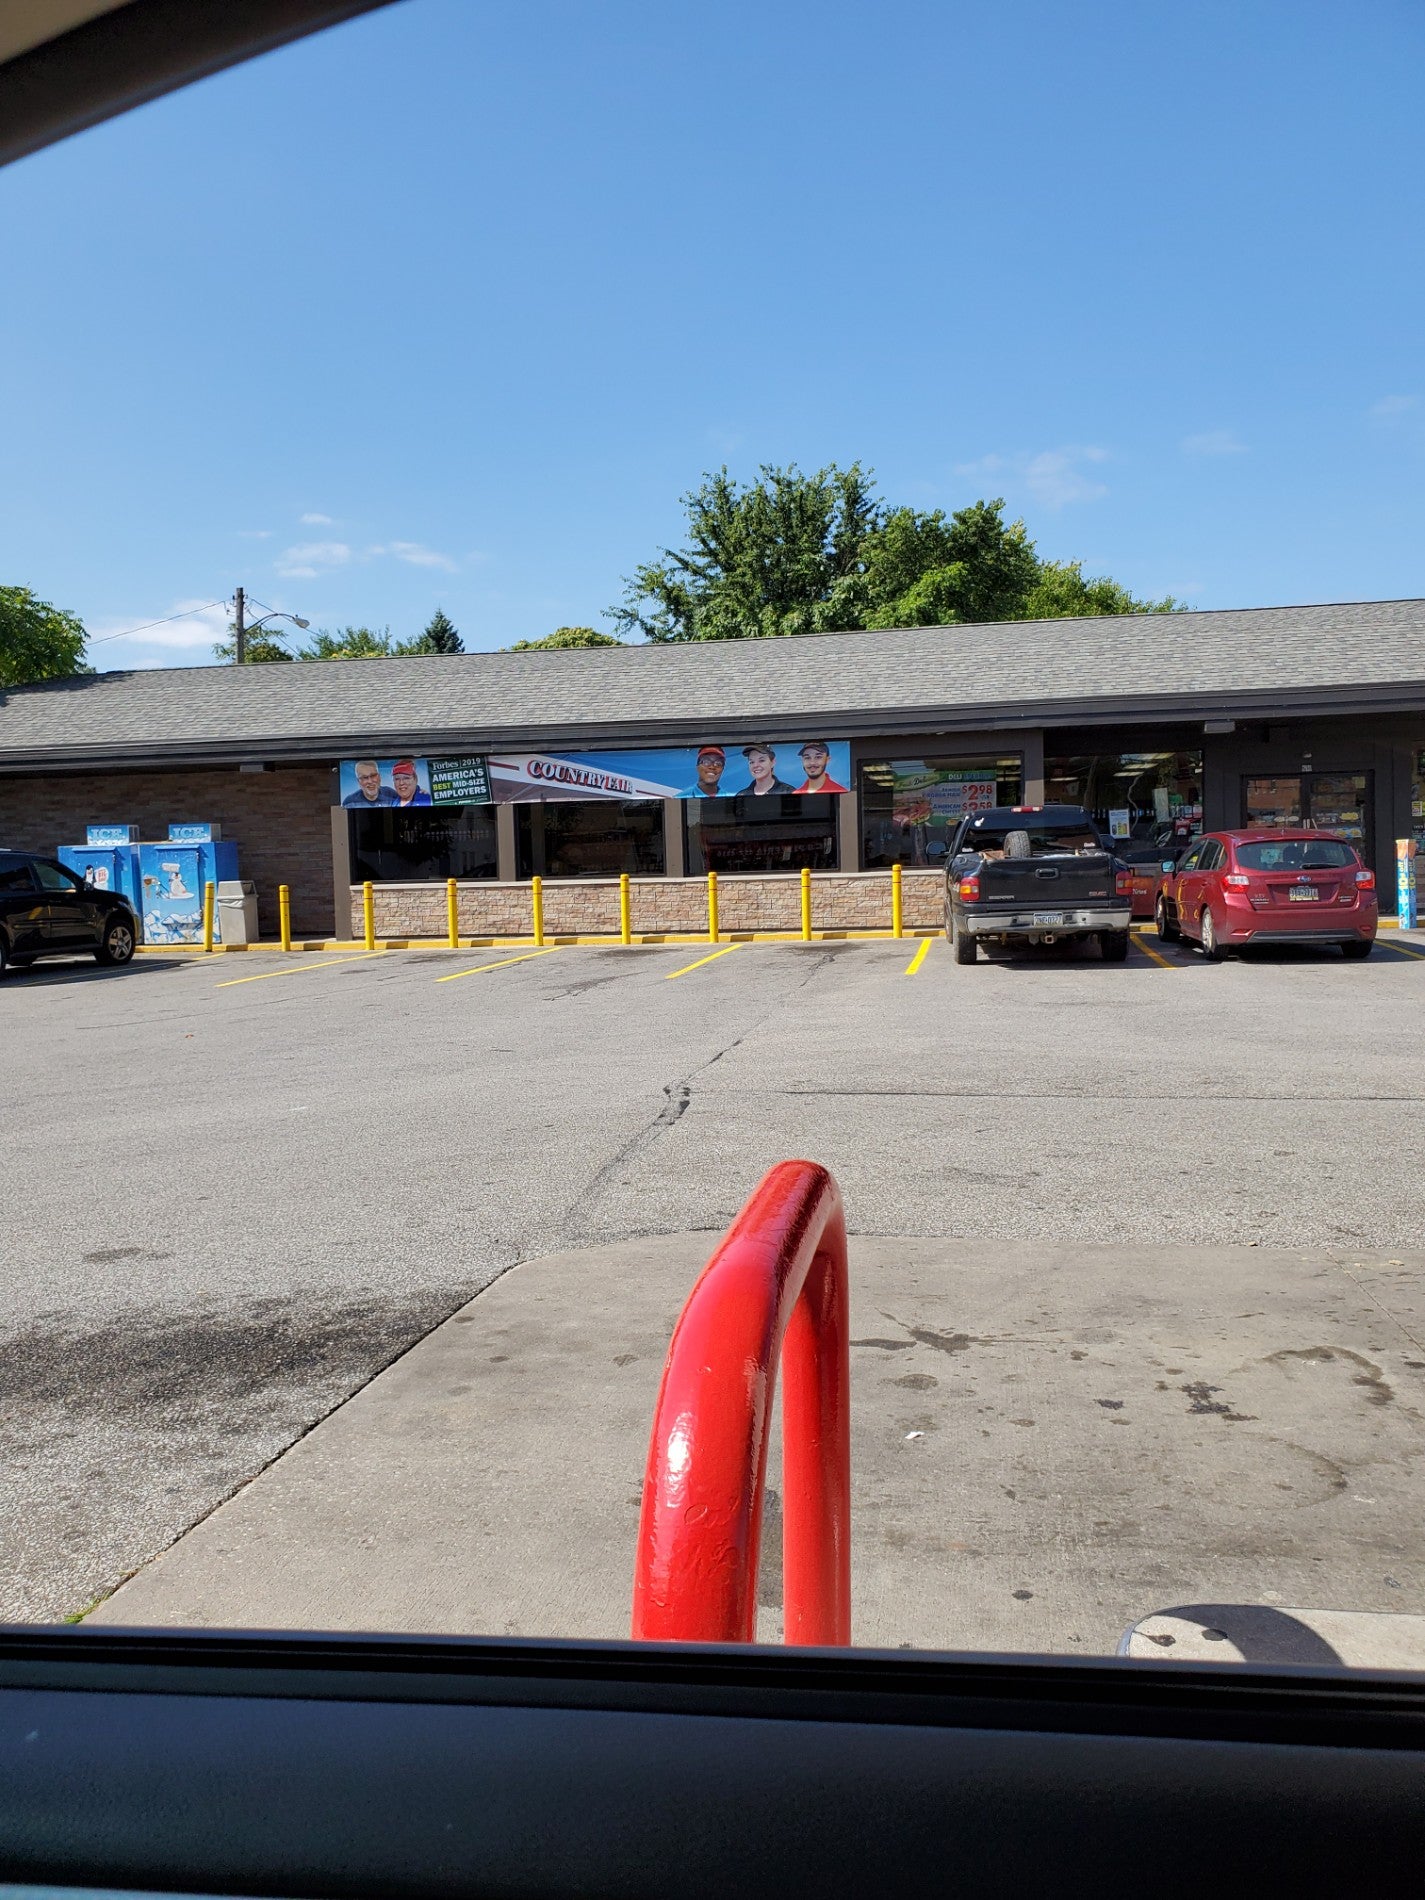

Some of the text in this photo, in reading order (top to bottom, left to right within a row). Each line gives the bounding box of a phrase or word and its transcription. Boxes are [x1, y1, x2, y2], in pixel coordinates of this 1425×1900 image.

[432, 757, 481, 770] Forbes 2019
[432, 768, 484, 782] AMERICA'S
[527, 760, 633, 794] COUNTRY FAIR
[433, 778, 485, 791] BEST MID-SIZE
[433, 785, 487, 799] EMPLOYERS
[91, 828, 123, 840] ICE
[173, 827, 205, 839] ICE
